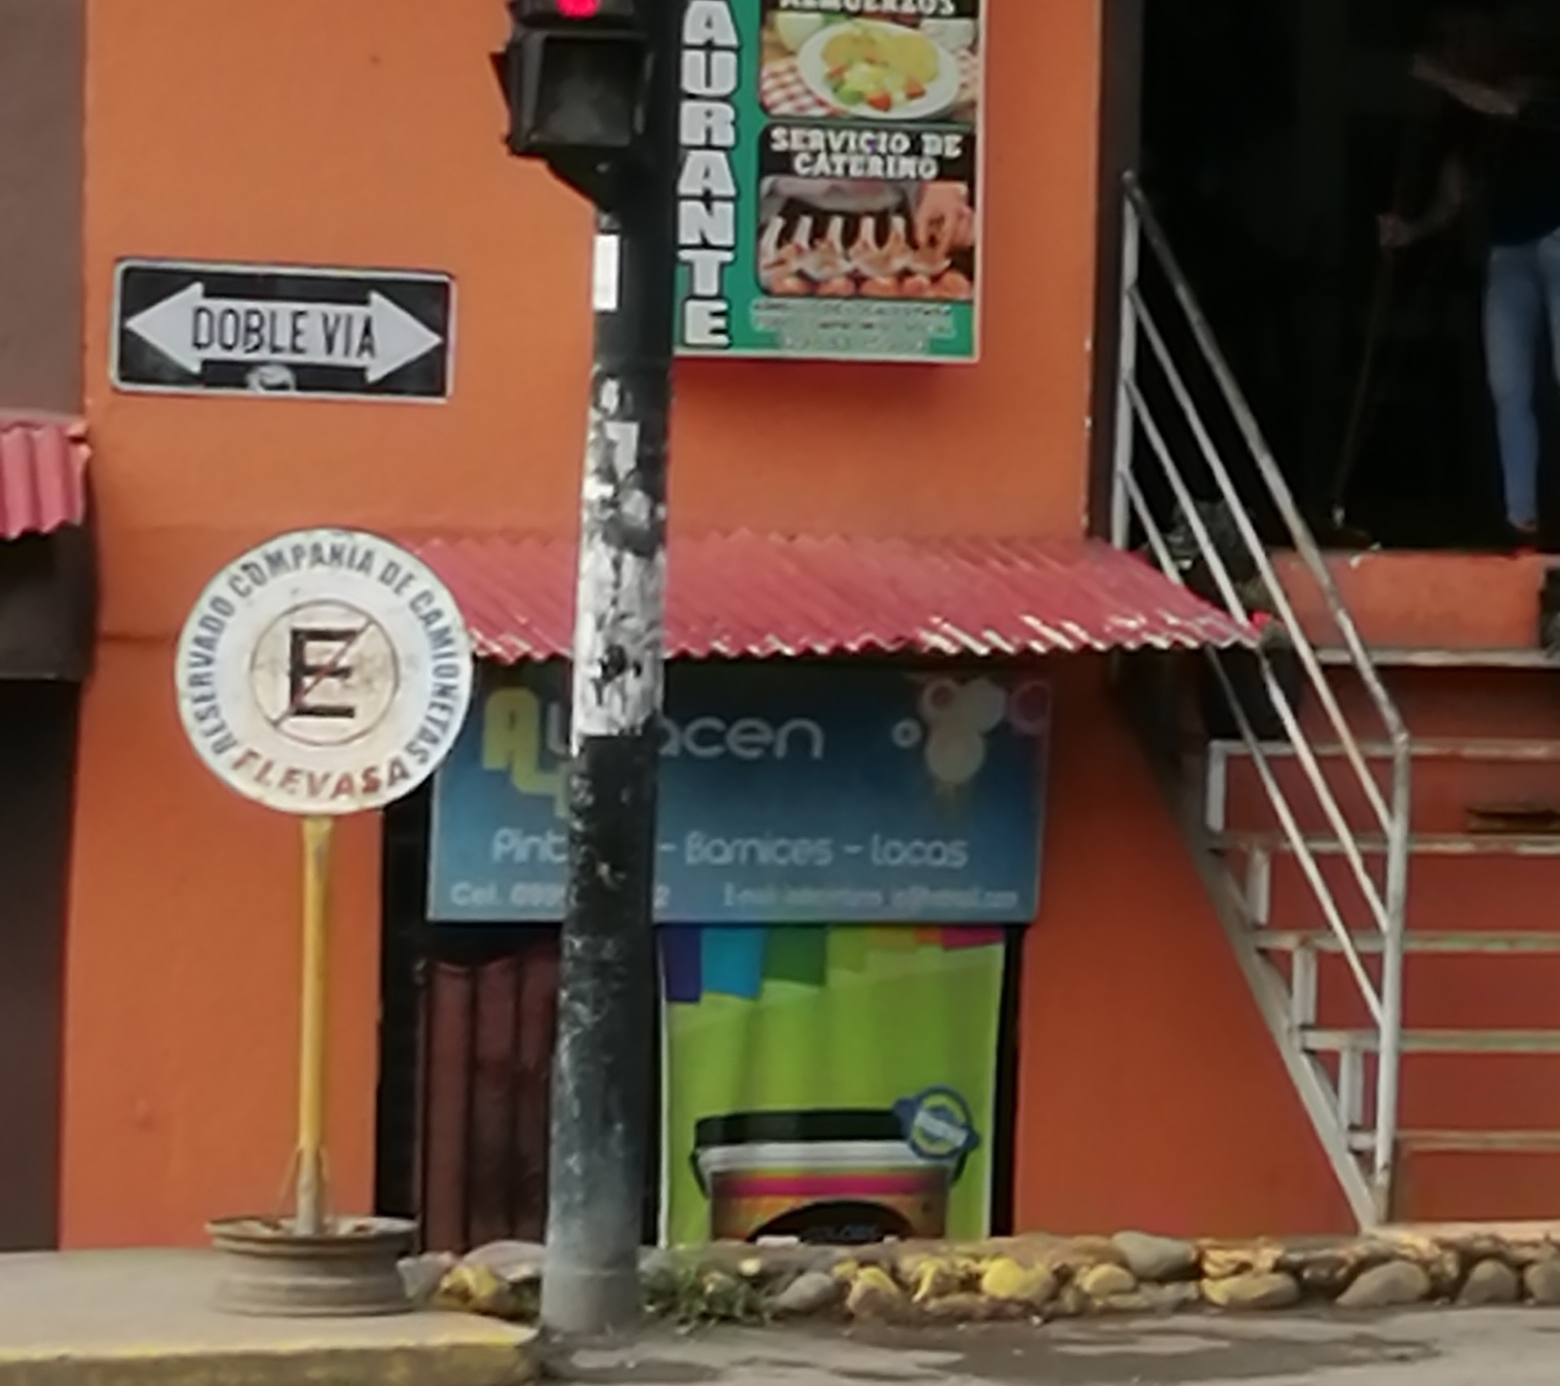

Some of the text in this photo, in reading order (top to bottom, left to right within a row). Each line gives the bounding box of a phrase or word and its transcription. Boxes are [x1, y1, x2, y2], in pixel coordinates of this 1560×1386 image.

[770, 126, 963, 158] SERVICIO DE
[794, 151, 939, 180] CATERING
[192, 307, 376, 359] DOBLE VIA
[188, 595, 238, 755] RESERVADO
[379, 558, 416, 596] DE
[405, 589, 461, 765] CAMIONETAS
[288, 627, 356, 718] E
[231, 749, 412, 800] FLEVASA
